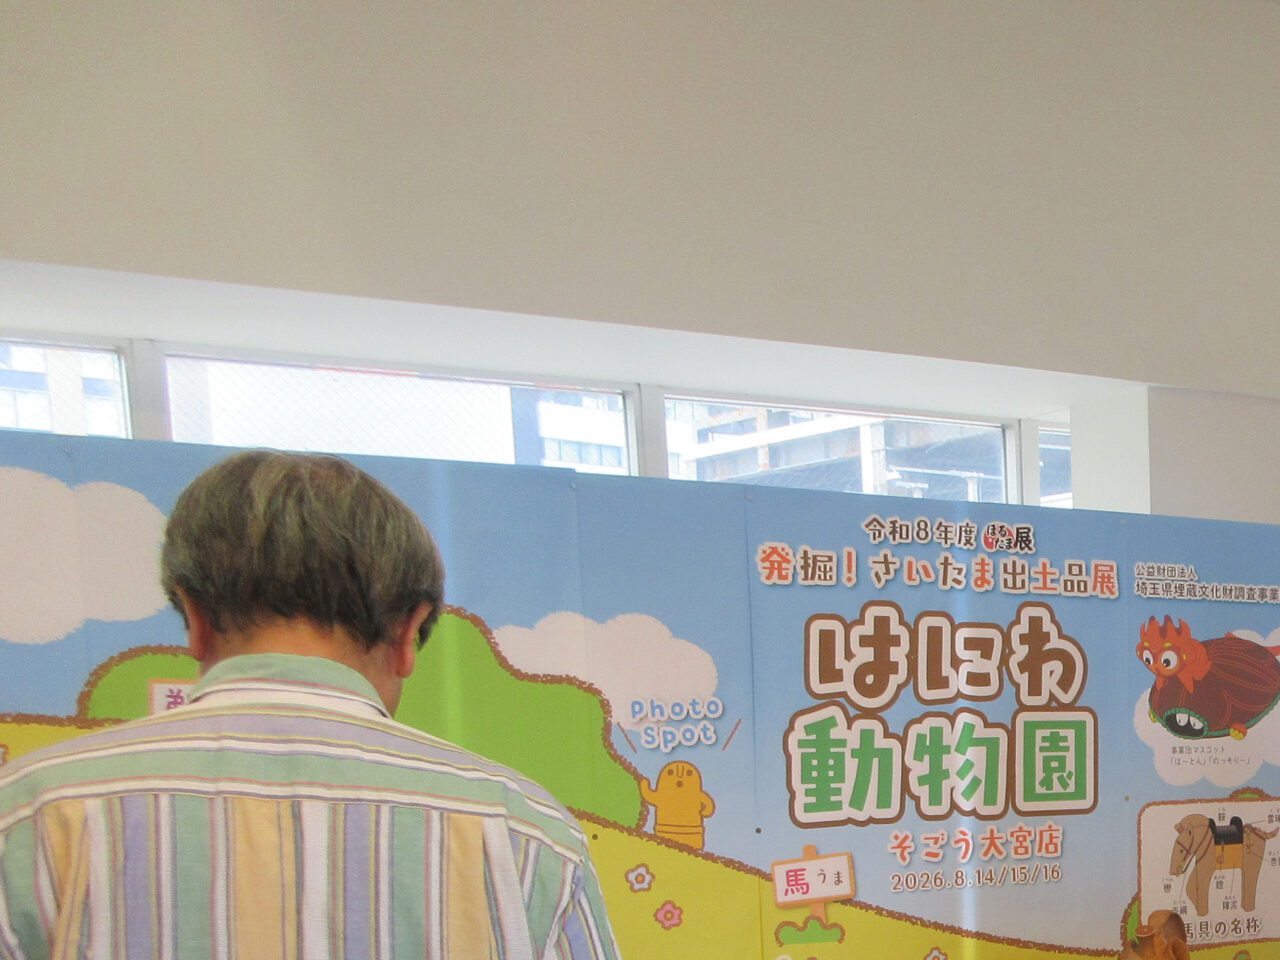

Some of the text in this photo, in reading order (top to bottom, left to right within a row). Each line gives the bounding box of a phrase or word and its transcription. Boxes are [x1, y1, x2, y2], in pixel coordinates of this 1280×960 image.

[864, 517, 976, 545] 令和8年度
[1135, 565, 1197, 579] 公益財団法人
[811, 609, 1083, 705] はにわ
[792, 710, 1092, 817] 動物園
[890, 824, 1062, 862] そごう大宮店
[784, 868, 844, 896] 馬 うま
[890, 864, 1061, 891] 2026.8.14/15/16
